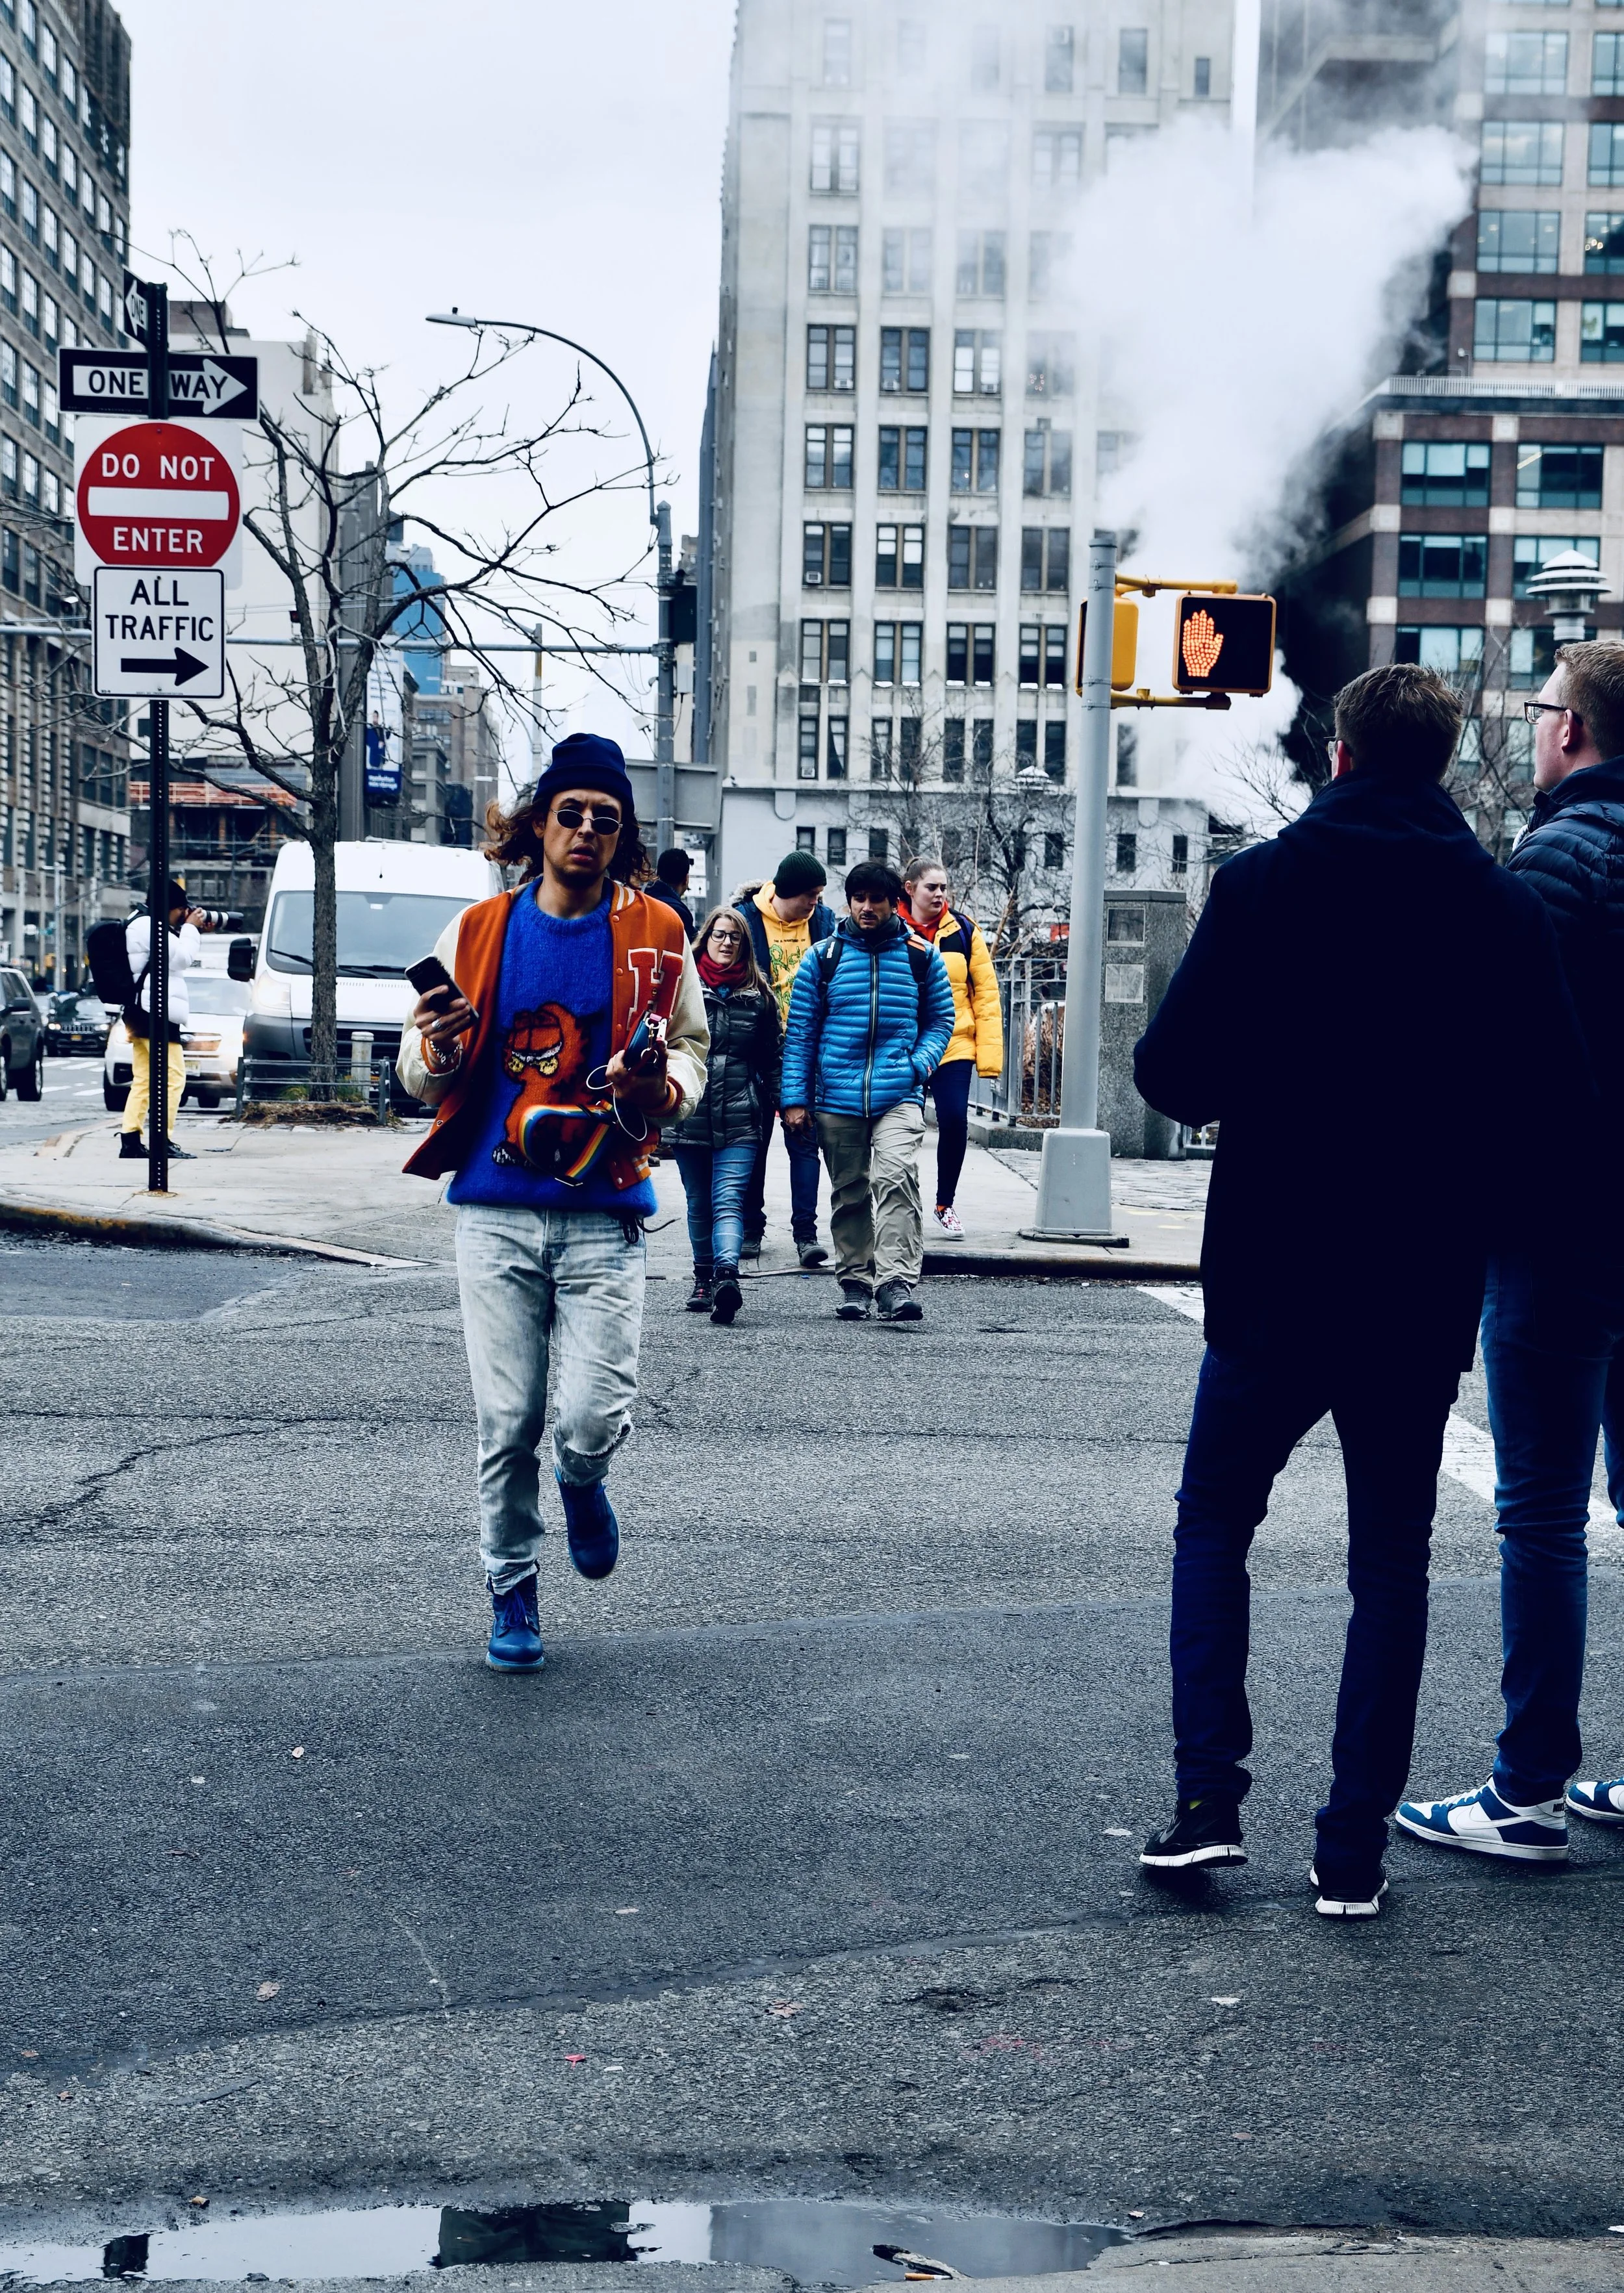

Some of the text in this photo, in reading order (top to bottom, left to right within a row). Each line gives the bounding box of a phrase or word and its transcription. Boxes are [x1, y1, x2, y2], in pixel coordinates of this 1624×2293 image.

[131, 294, 144, 325] ONE
[89, 370, 228, 399] ONE WAY
[103, 453, 215, 481] DO NOT
[114, 527, 203, 553] ENTER
[131, 579, 189, 607] ALL
[105, 614, 214, 642] TRAFFIC
